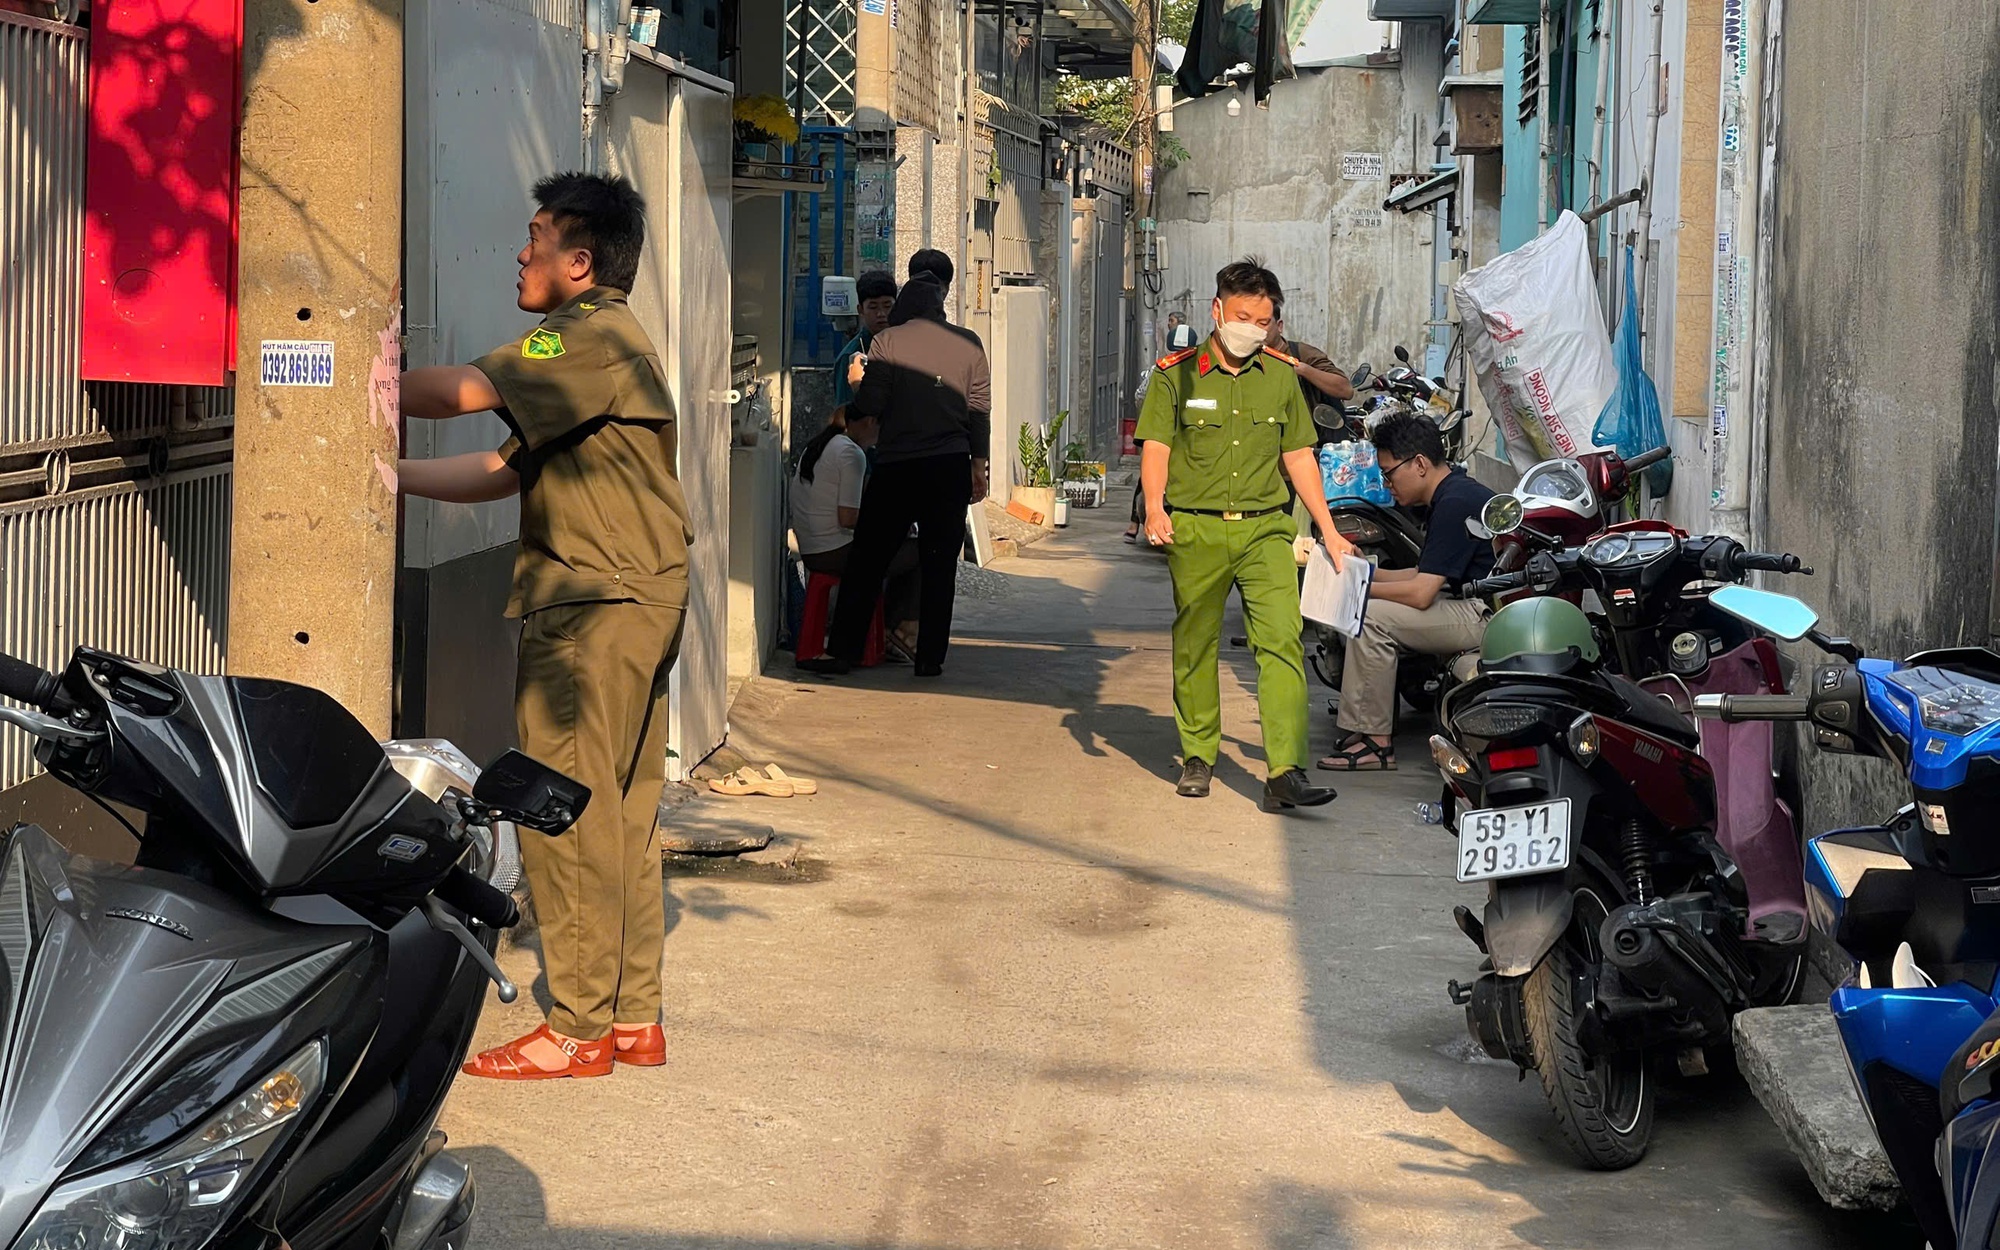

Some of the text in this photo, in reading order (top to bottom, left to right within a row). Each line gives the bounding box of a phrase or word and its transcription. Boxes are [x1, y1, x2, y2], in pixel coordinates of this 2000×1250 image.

[262, 352, 332, 385] 0392.869.869
[1633, 738, 1664, 764] YAMAHA
[1464, 836, 1562, 877] 293.62
[105, 907, 194, 940] HONDA
